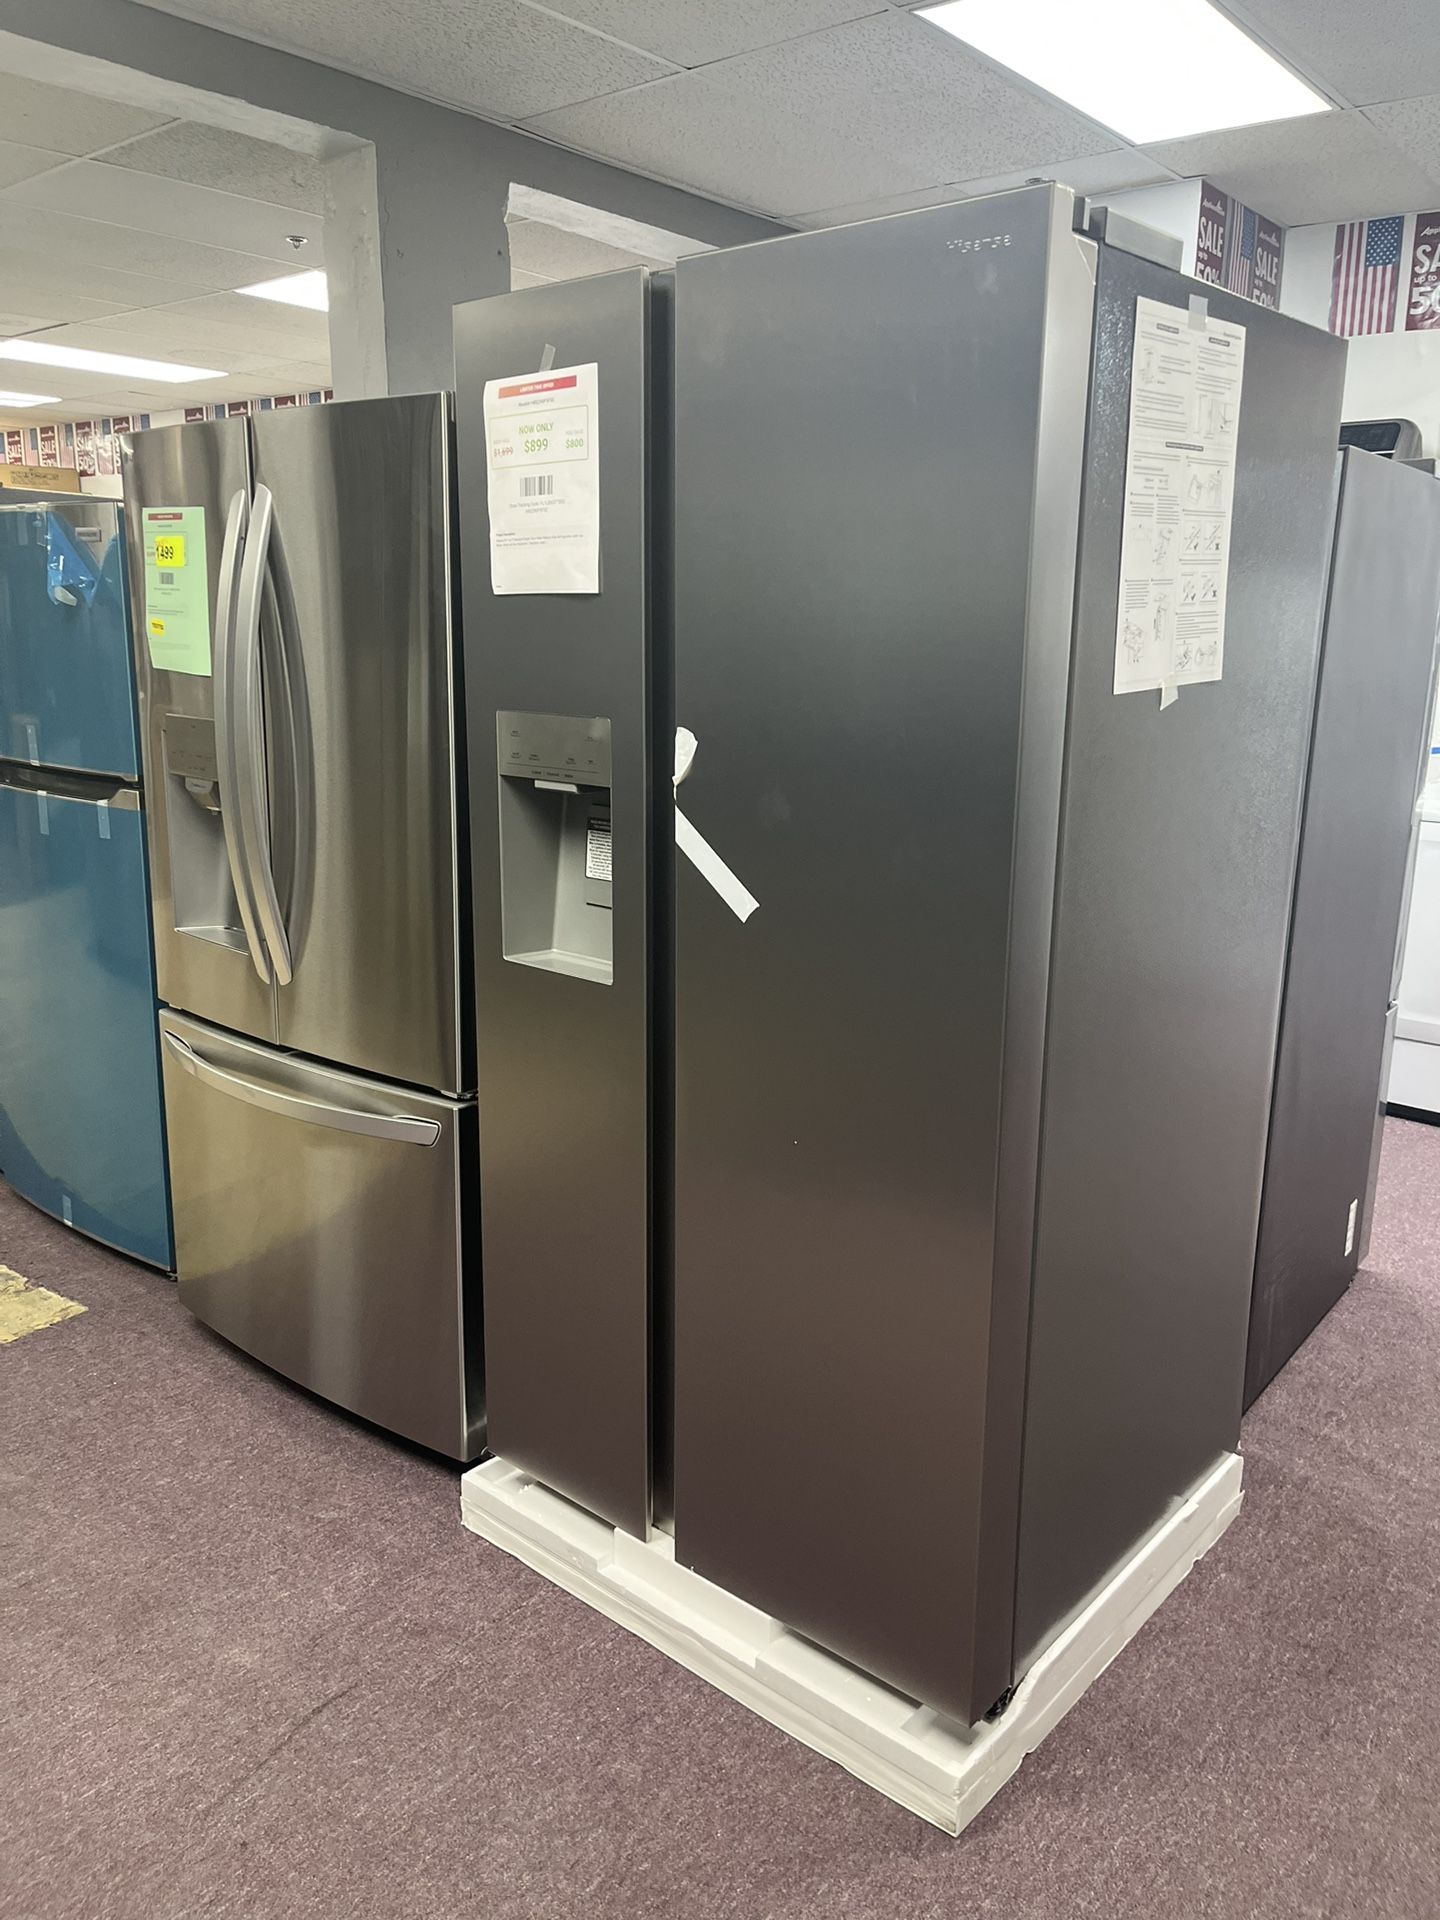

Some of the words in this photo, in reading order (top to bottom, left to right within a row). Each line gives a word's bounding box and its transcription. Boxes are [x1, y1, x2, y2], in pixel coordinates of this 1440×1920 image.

[1199, 216, 1224, 258] SALE
[1255, 247, 1279, 286] SALE
[518, 425, 534, 435] NOW
[536, 422, 554, 433] ONLY
[524, 438, 549, 454] $899
